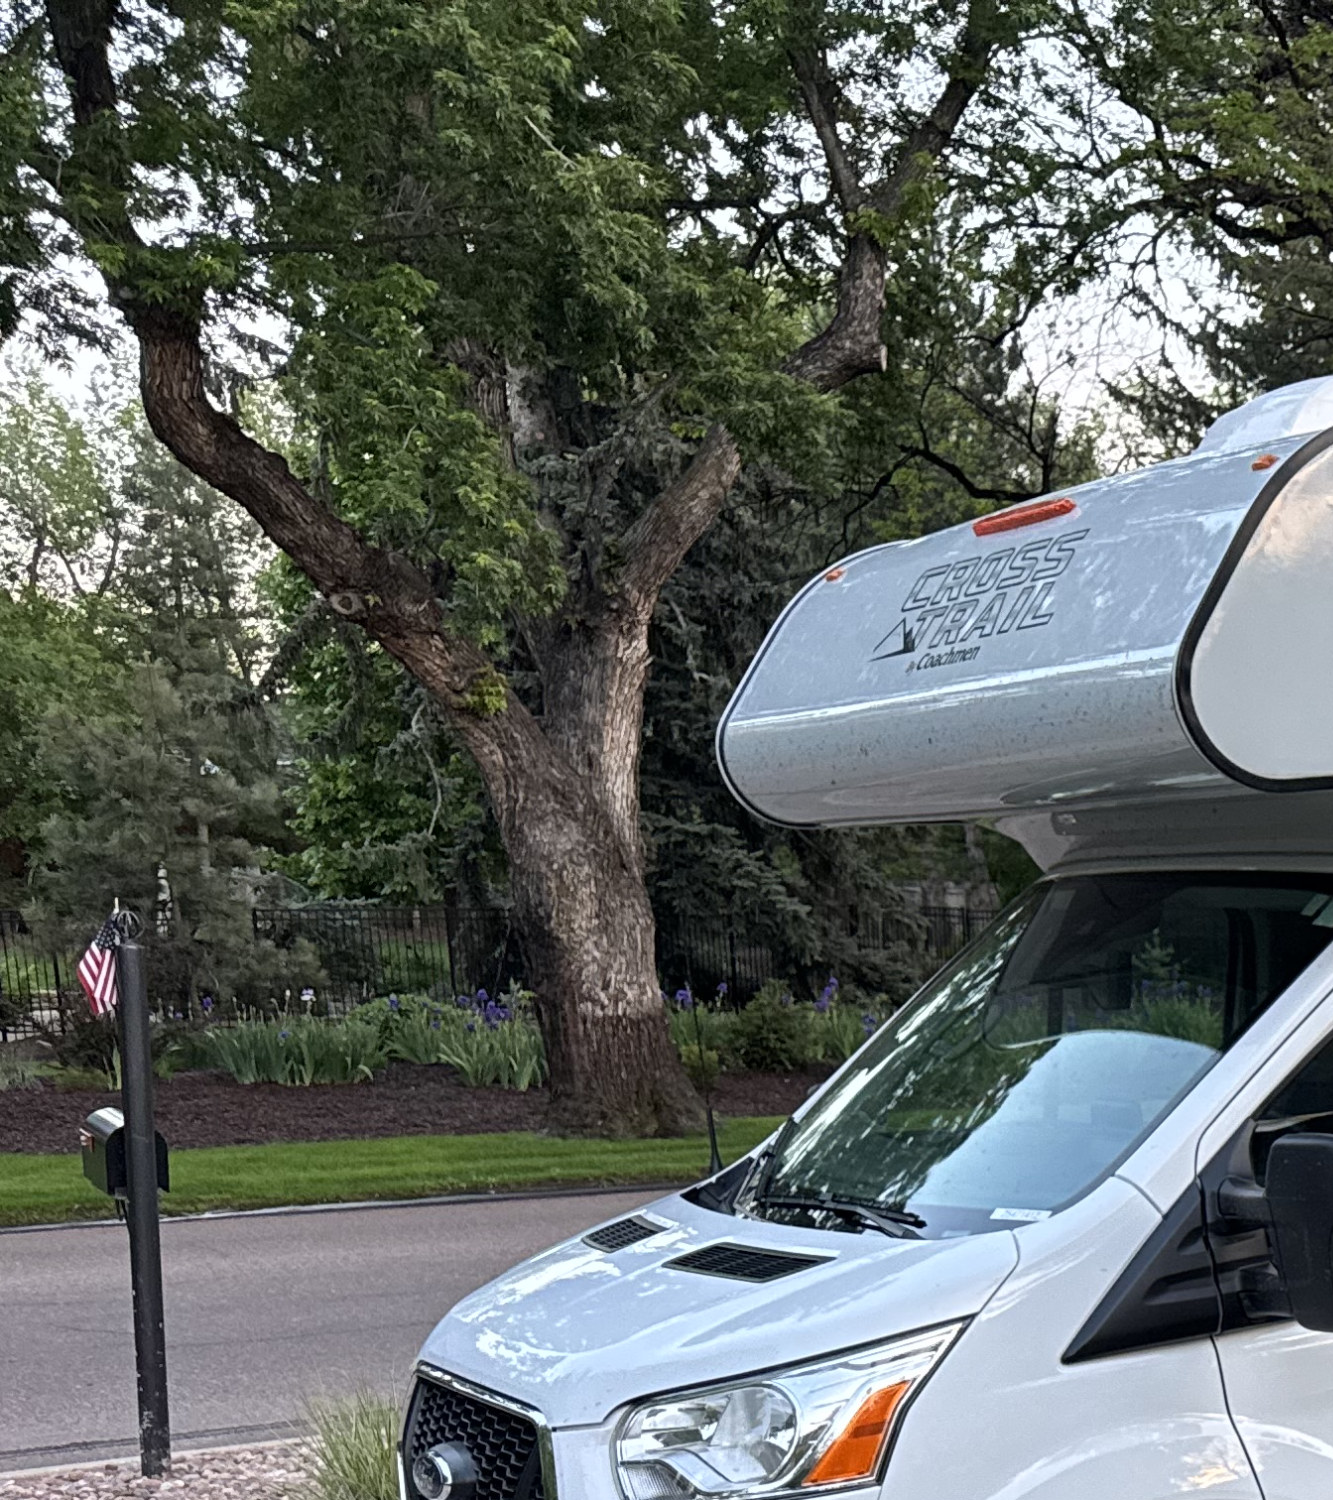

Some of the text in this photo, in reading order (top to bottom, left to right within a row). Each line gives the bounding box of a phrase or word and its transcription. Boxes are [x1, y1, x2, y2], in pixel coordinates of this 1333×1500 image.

[901, 528, 1091, 612] CROSS
[913, 580, 1056, 650] TRAIL
[916, 646, 981, 671] Coachmen
